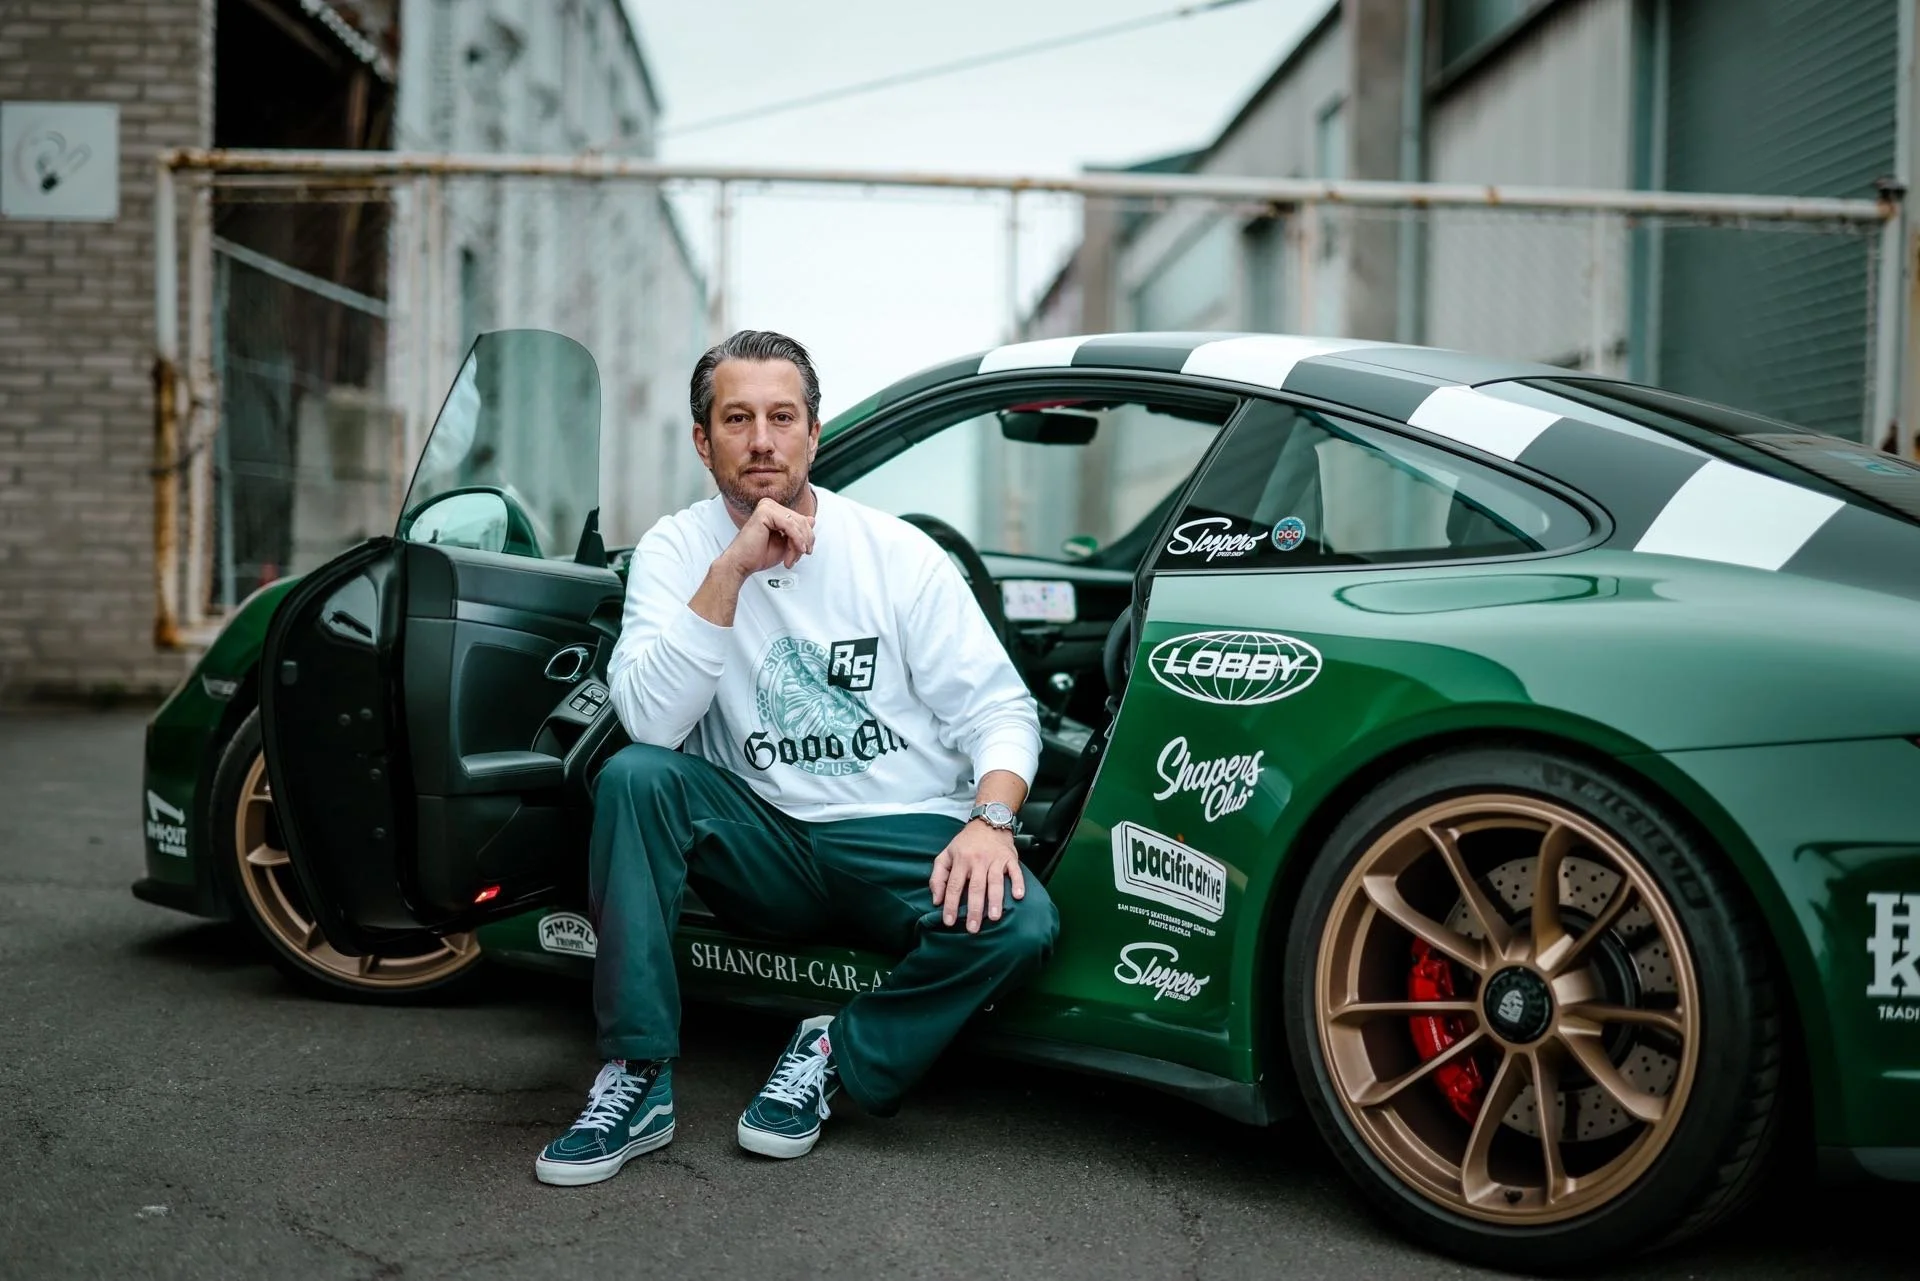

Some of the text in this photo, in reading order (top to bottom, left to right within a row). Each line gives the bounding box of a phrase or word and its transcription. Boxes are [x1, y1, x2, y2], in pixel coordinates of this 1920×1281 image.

[1167, 517, 1268, 562] Sleepers
[831, 644, 874, 688] RS
[1163, 647, 1309, 682] LOBBY
[743, 731, 845, 771] Good
[831, 762, 853, 776] US
[1153, 736, 1264, 804] Shapers
[1204, 781, 1248, 822] Club
[1131, 837, 1222, 904] pacific drive
[545, 920, 594, 945] AMPAL
[1117, 903, 1129, 911] SAN
[1129, 905, 1150, 917] DIEGO'S
[1150, 911, 1181, 925] SKATEBOARD
[1181, 919, 1193, 929] SHOP
[1148, 919, 1168, 930] PACIFIC
[1114, 942, 1210, 1001] Sleepers
